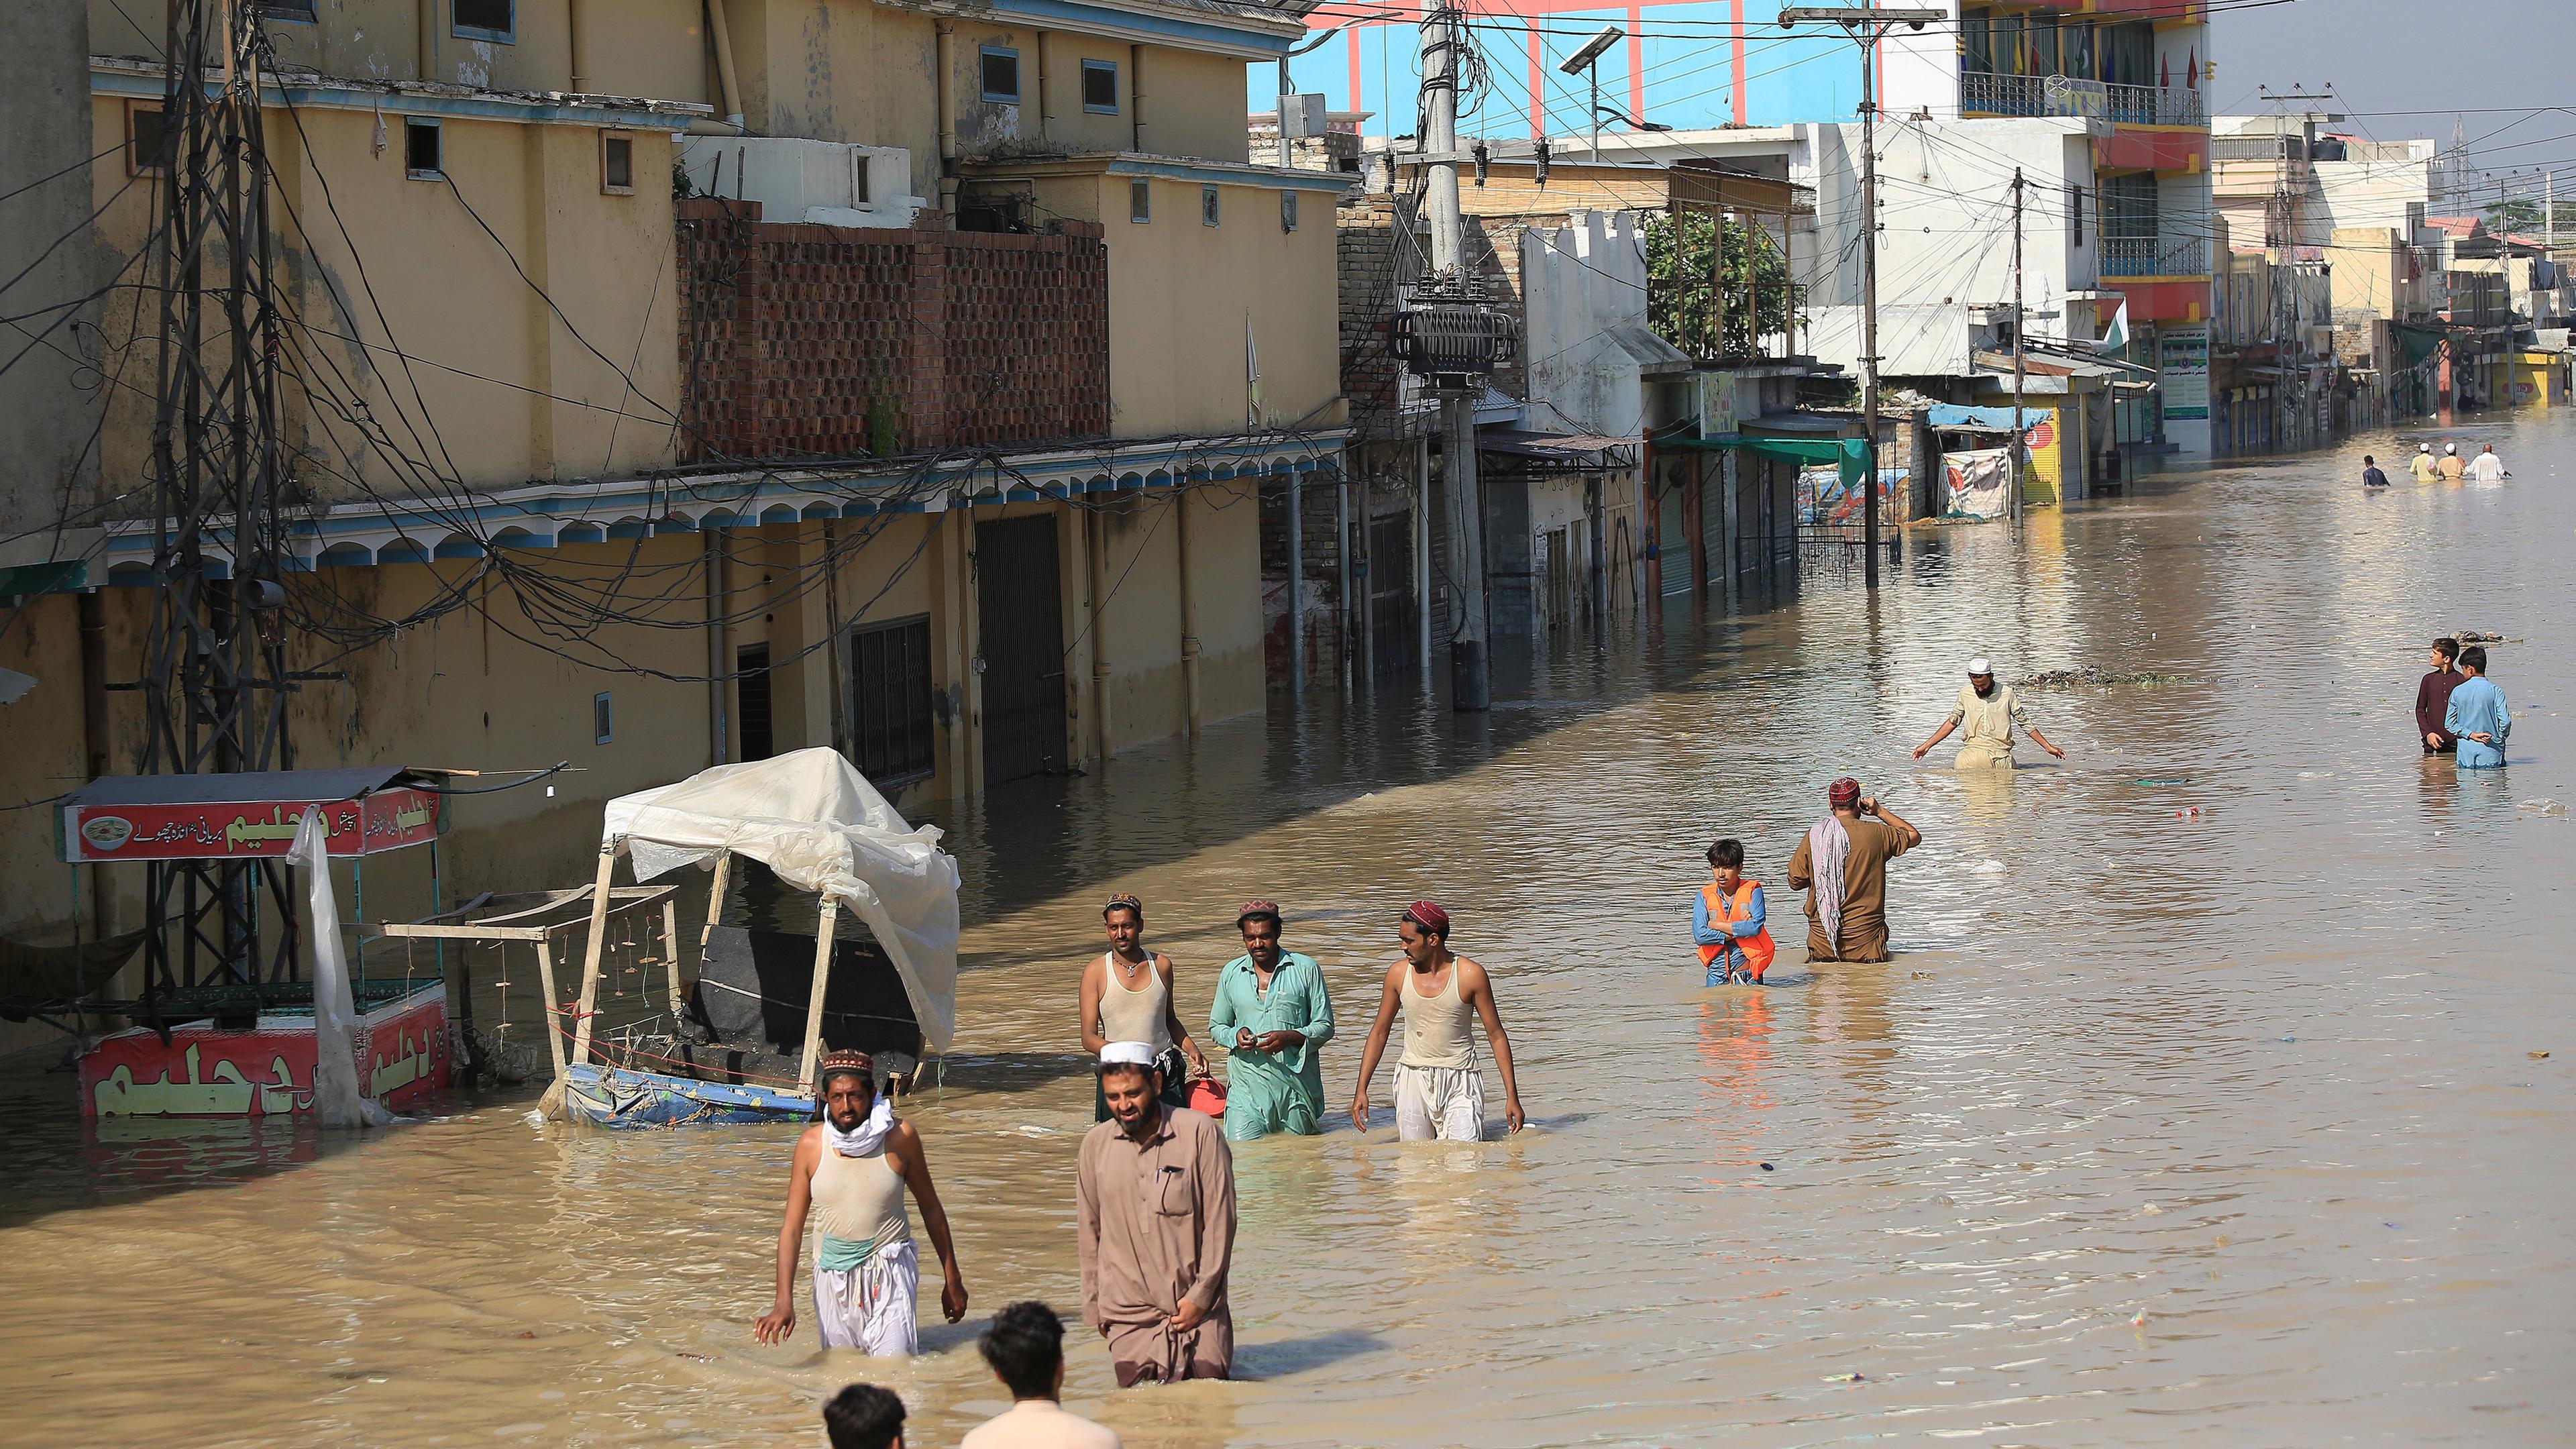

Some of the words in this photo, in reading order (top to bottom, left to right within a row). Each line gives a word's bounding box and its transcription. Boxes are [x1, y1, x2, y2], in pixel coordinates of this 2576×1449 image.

[133, 821, 174, 843] چھولے
[197, 814, 224, 844] بریانی
[331, 810, 358, 837] اسپیشل
